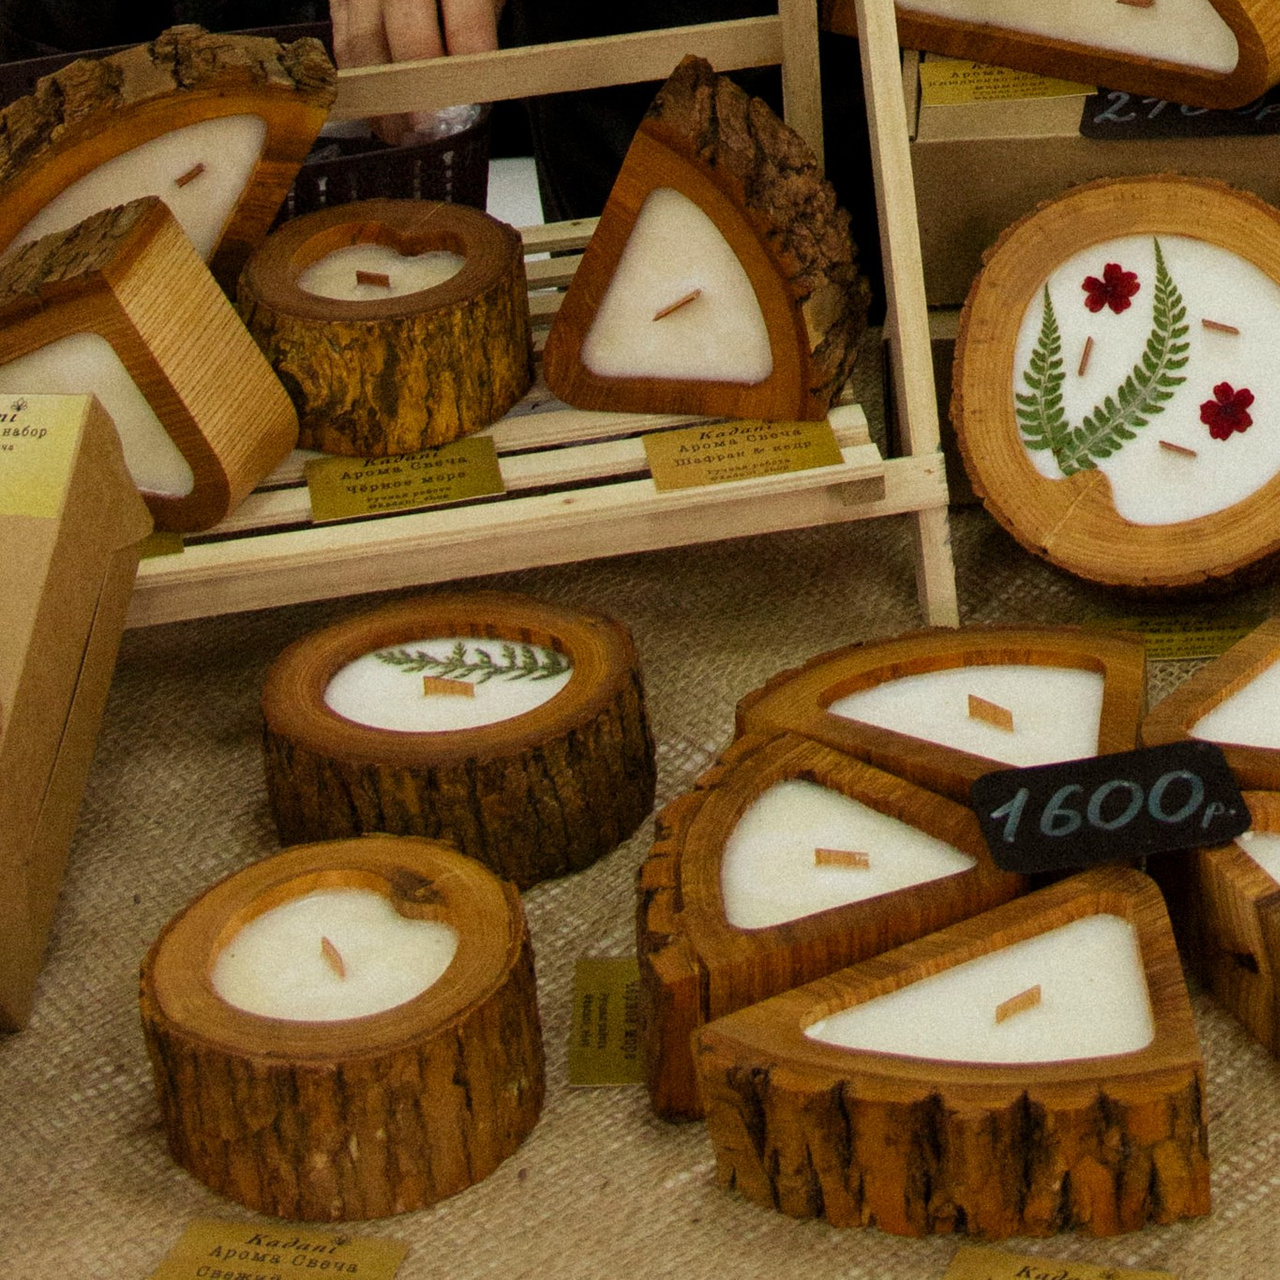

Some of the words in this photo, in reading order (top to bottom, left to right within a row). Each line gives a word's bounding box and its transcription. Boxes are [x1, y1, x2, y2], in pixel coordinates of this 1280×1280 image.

[2, 424, 48, 439] набор
[679, 439, 739, 453] Арома
[746, 430, 803, 442] Свеча
[341, 464, 404, 481] Арома
[411, 455, 468, 470] Свеча
[674, 450, 745, 467] Шафран
[421, 471, 466, 485] море
[208, 1245, 281, 1265] Арома
[291, 1254, 360, 1274] Свеча
